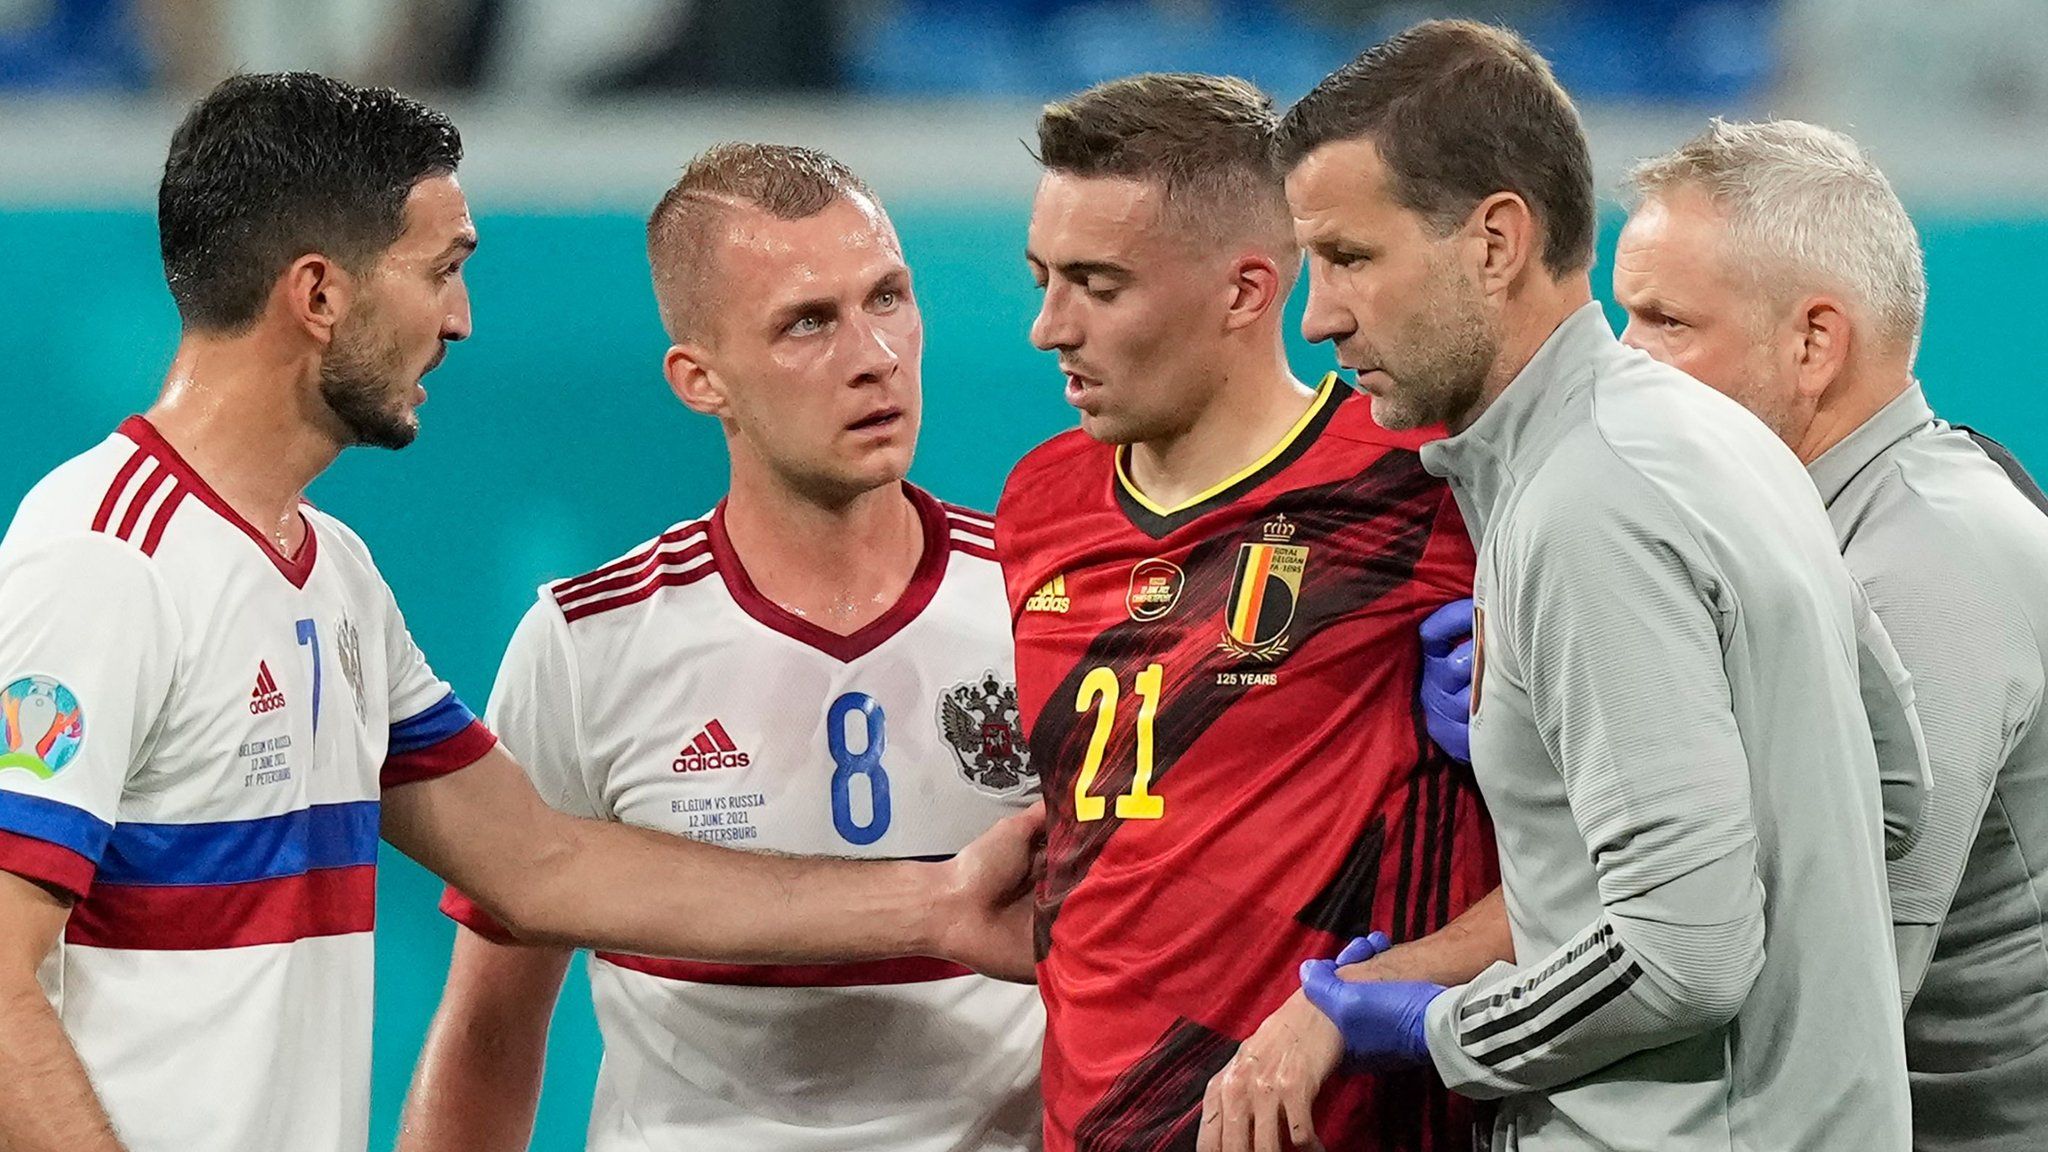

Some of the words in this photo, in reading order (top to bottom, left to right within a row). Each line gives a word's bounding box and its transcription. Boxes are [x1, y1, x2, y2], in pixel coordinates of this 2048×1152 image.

[1025, 593, 1071, 613] adidas
[1216, 673, 1238, 685] 125
[1239, 673, 1278, 686] YEARS
[249, 692, 286, 715] adidas
[295, 618, 321, 770] 7
[1075, 663, 1165, 822] 21
[672, 751, 750, 773] adidas
[827, 691, 891, 845] 8
[671, 798, 712, 813] BELGIUM
[714, 796, 727, 810] VS
[728, 793, 765, 809] RUSSIA
[688, 814, 699, 827] 12
[700, 813, 725, 827] JUNE
[726, 811, 749, 825] 2021
[698, 826, 757, 843] PETERSBURG
